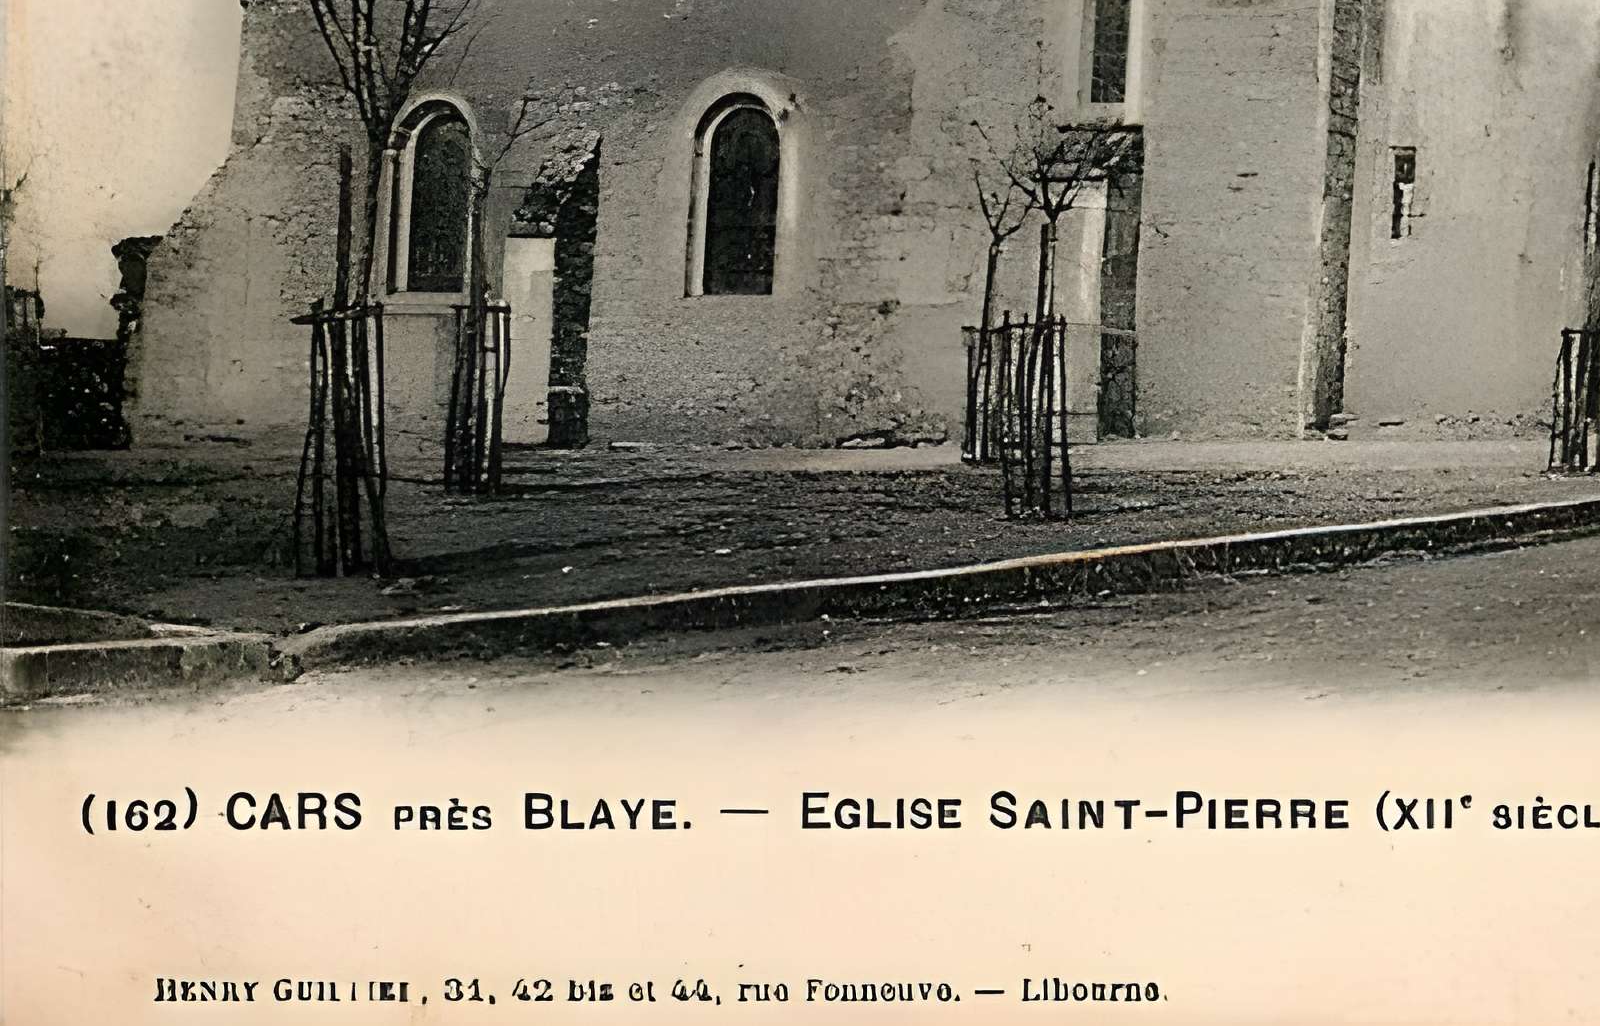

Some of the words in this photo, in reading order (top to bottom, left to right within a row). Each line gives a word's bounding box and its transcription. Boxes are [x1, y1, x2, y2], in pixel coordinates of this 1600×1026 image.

[82, 785, 197, 836] (162)
[223, 791, 363, 831] CARS
[394, 796, 493, 831] PRÈS
[524, 791, 693, 831] BLAYE.
[801, 791, 963, 831] EGLISE
[989, 790, 1351, 831] SAINT-PIERRE
[153, 977, 260, 1003] HENRY
[444, 977, 497, 1006] 31,
[511, 977, 555, 1003] 42
[567, 978, 615, 1003] bis
[628, 980, 657, 1003] et
[671, 977, 722, 1006] 44,
[737, 978, 790, 1003] rue
[1021, 977, 1169, 1003] Libourne.
